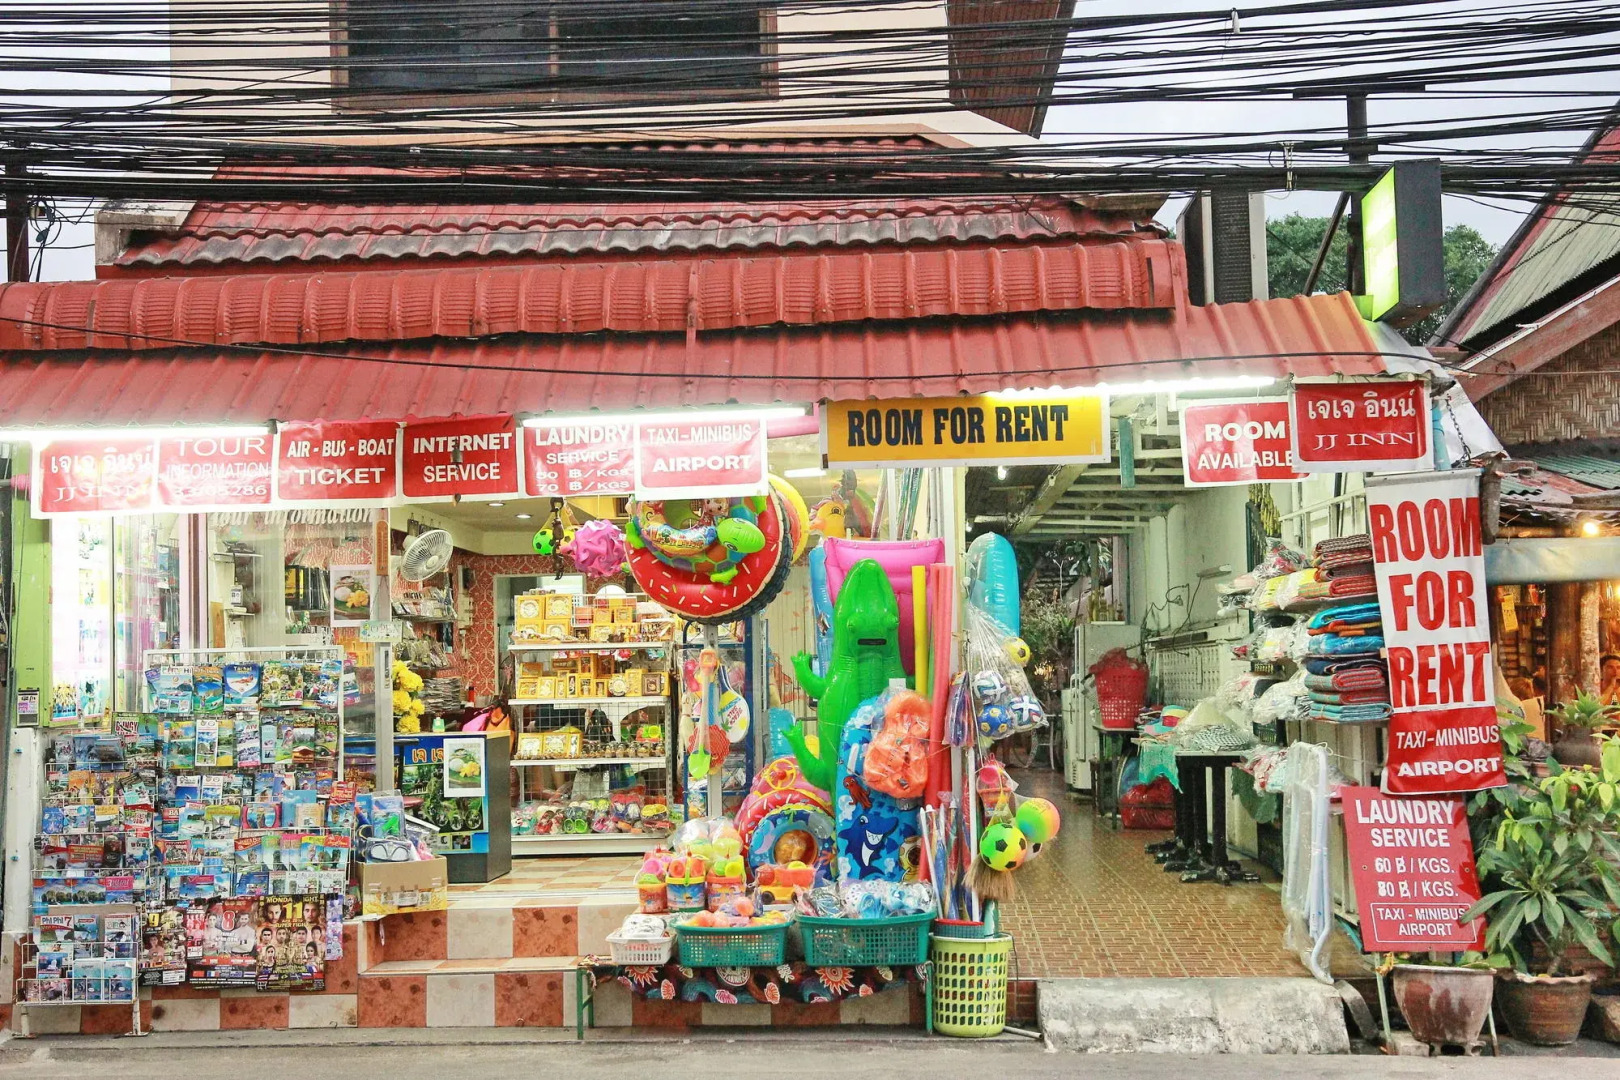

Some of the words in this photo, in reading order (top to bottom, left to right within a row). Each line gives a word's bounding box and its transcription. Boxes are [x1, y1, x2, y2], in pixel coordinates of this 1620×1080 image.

[535, 424, 630, 446] LAUNDRY
[847, 408, 923, 447] ROOM
[933, 406, 985, 445] FOR
[995, 404, 1069, 443] RENT
[1204, 421, 1286, 442] ROOM
[173, 437, 266, 457] TOUR
[287, 440, 310, 458] AIR
[322, 439, 346, 457] BUS
[358, 438, 394, 456] BOAT
[413, 432, 512, 454] INTERNET
[1314, 434, 1339, 451] JJ
[1346, 432, 1415, 446] INN
[546, 450, 619, 465] SERVICE
[652, 455, 752, 473] AIRPORT
[167, 462, 269, 481] INFORMATION
[293, 467, 386, 486] TICKET
[423, 463, 501, 483] SERVICE
[1369, 496, 1482, 564] ROOM
[1388, 570, 1476, 631] FOR
[1387, 641, 1490, 708] RENT
[1397, 756, 1501, 778] AIRPORT
[1355, 800, 1454, 825] LAUNDRY
[1370, 828, 1450, 848] SERVICE
[221, 910, 236, 931] 8
[281, 902, 303, 919] 11
[1377, 908, 1404, 920] TAXI
[1414, 908, 1466, 921] MINIBUS
[1398, 923, 1453, 937] AIRPORT
